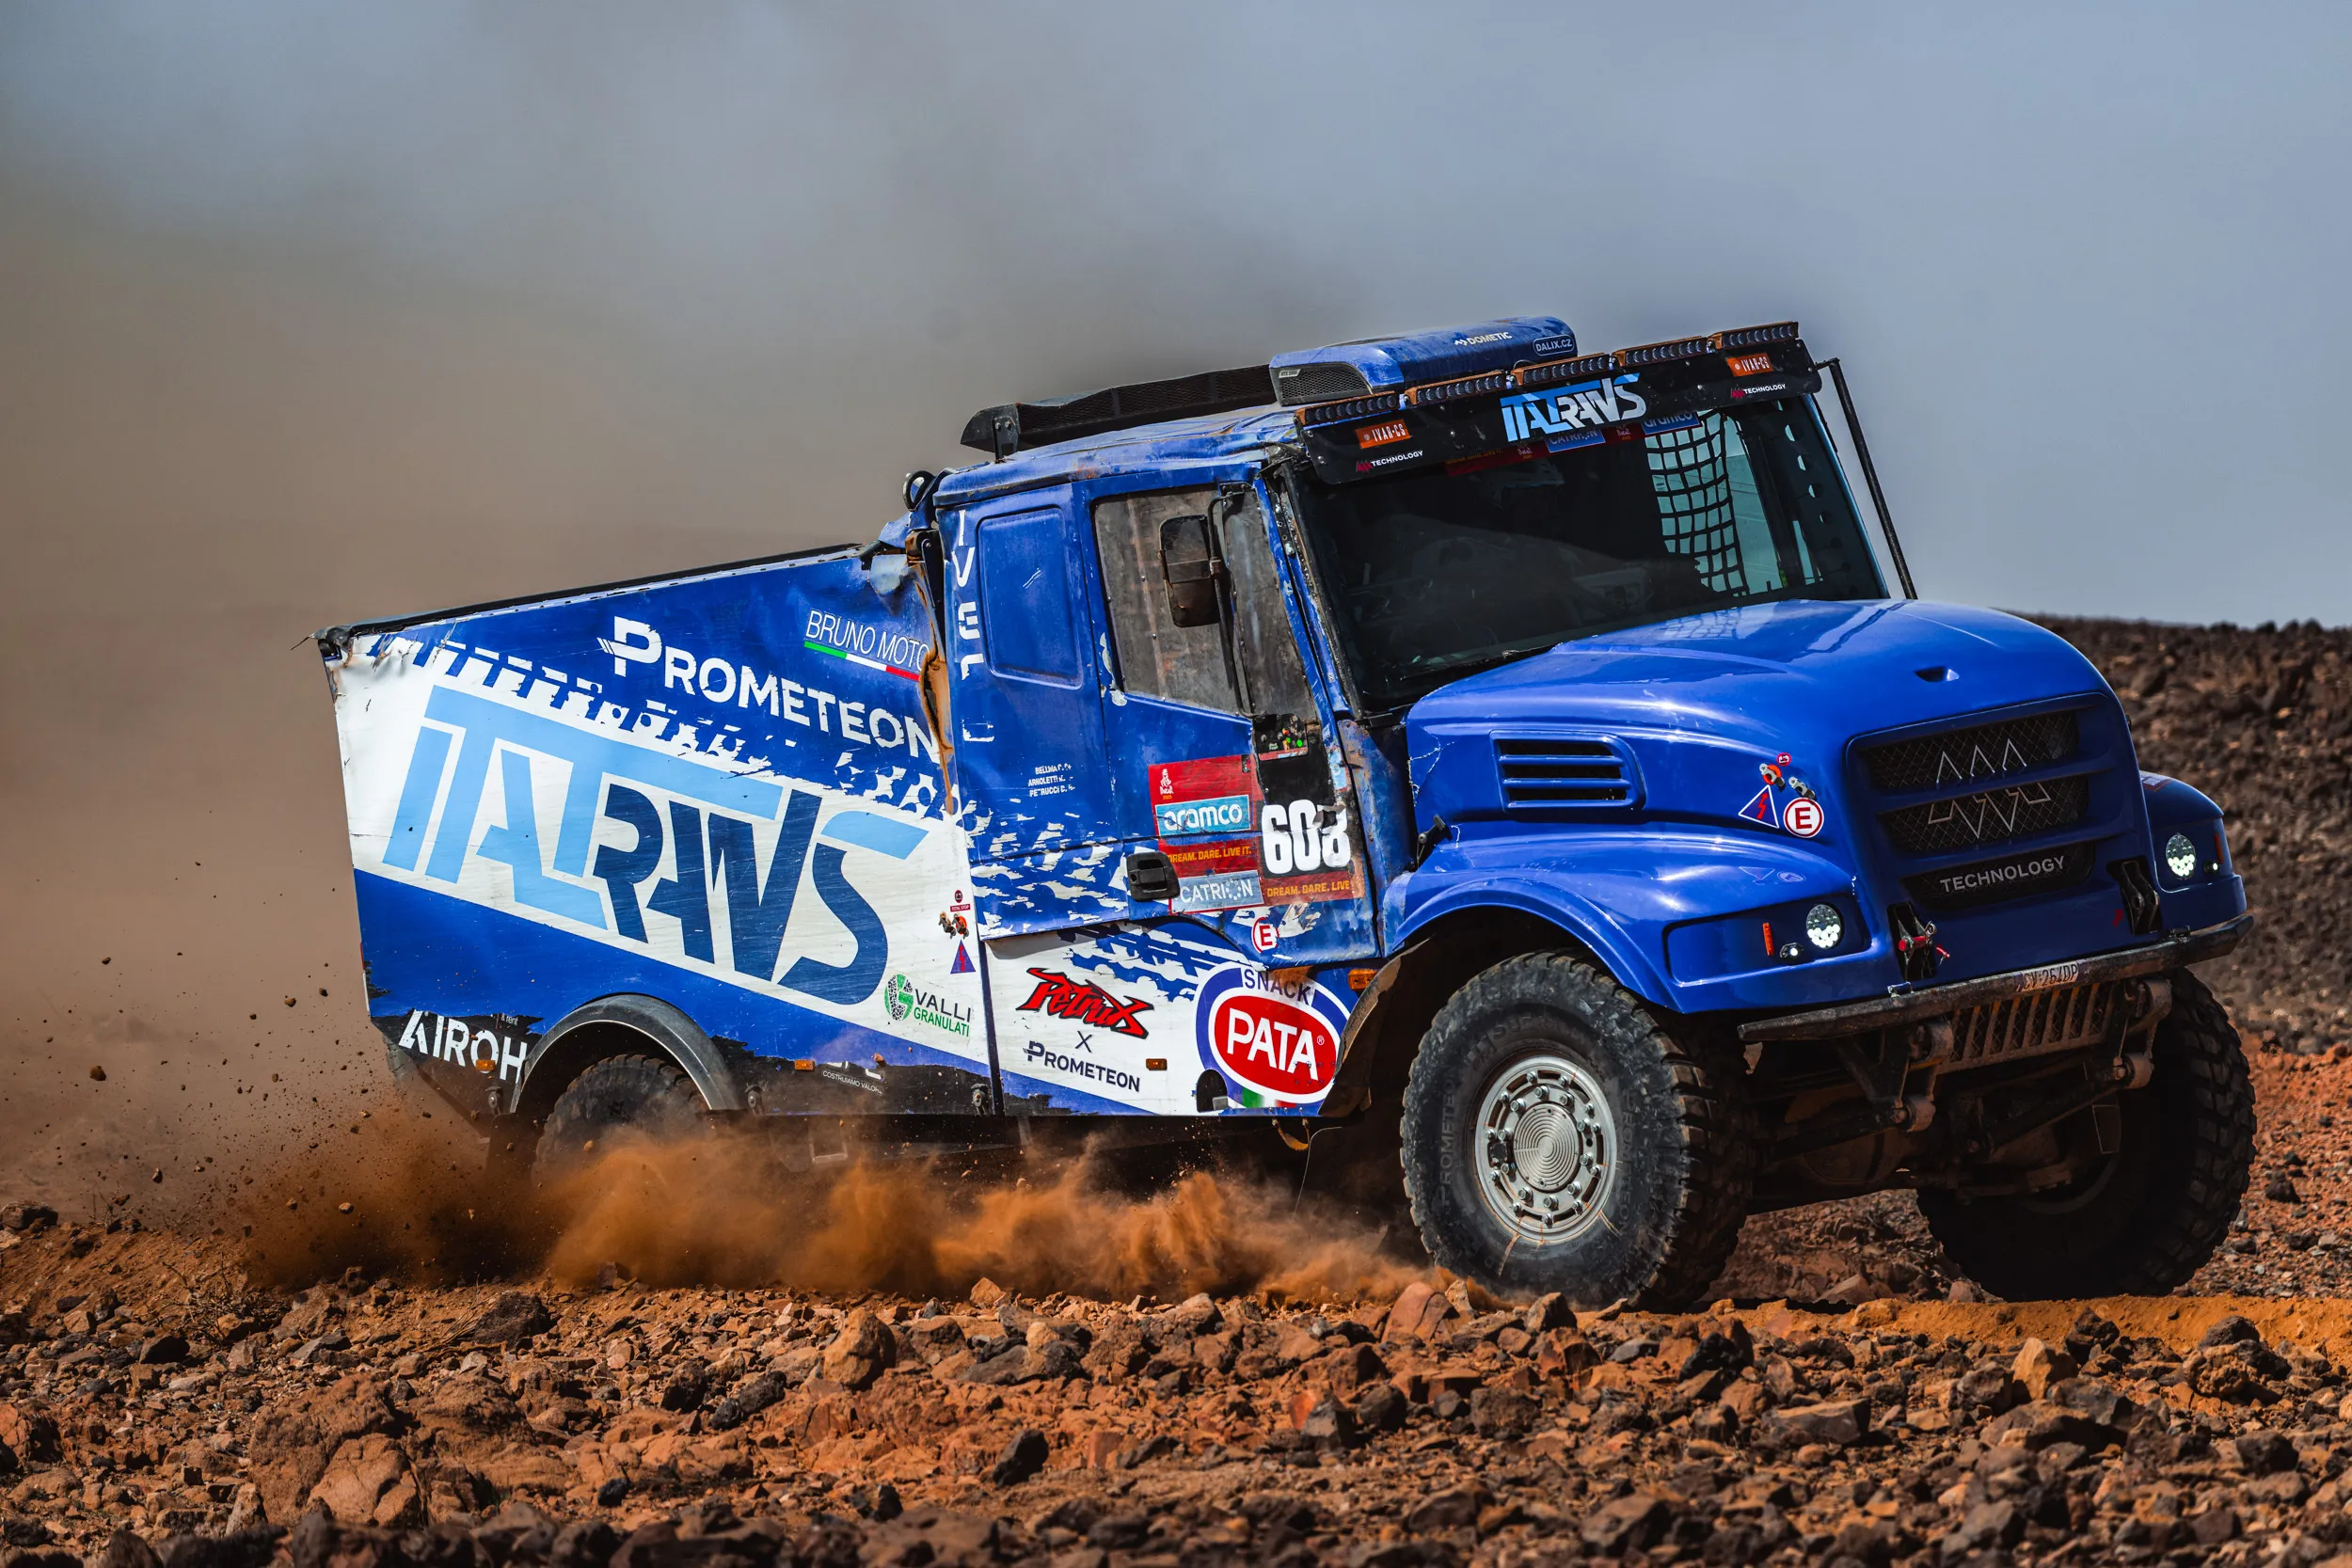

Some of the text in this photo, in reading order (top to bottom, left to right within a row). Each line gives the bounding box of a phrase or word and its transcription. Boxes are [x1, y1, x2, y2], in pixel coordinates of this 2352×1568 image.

[1467, 332, 1513, 345] DOMETIC
[1535, 340, 1573, 352] DALIX.CZ
[1743, 384, 1786, 395] TECHNOLOGY
[1371, 451, 1423, 467] TECHNOLOGY
[805, 610, 876, 655] BRUNO
[596, 616, 945, 765] PROMETEON
[1163, 803, 1243, 831] aramco
[1795, 806, 1813, 830] E
[1261, 799, 1351, 875] 608
[1199, 848, 1222, 860] DARE.
[1223, 847, 1241, 858] LIVE
[1242, 846, 1252, 855] IT.
[1266, 879, 1350, 897] DREAM. DARE. LIVE
[1939, 855, 2065, 893] TECHNOLOGY
[1259, 925, 1273, 946] E
[914, 988, 972, 1023] VALLI
[914, 1006, 970, 1037] GRANULATI
[398, 1008, 528, 1084] AIROH
[1227, 1007, 1319, 1081] PATA
[1022, 1039, 1140, 1092] PROMETEON
